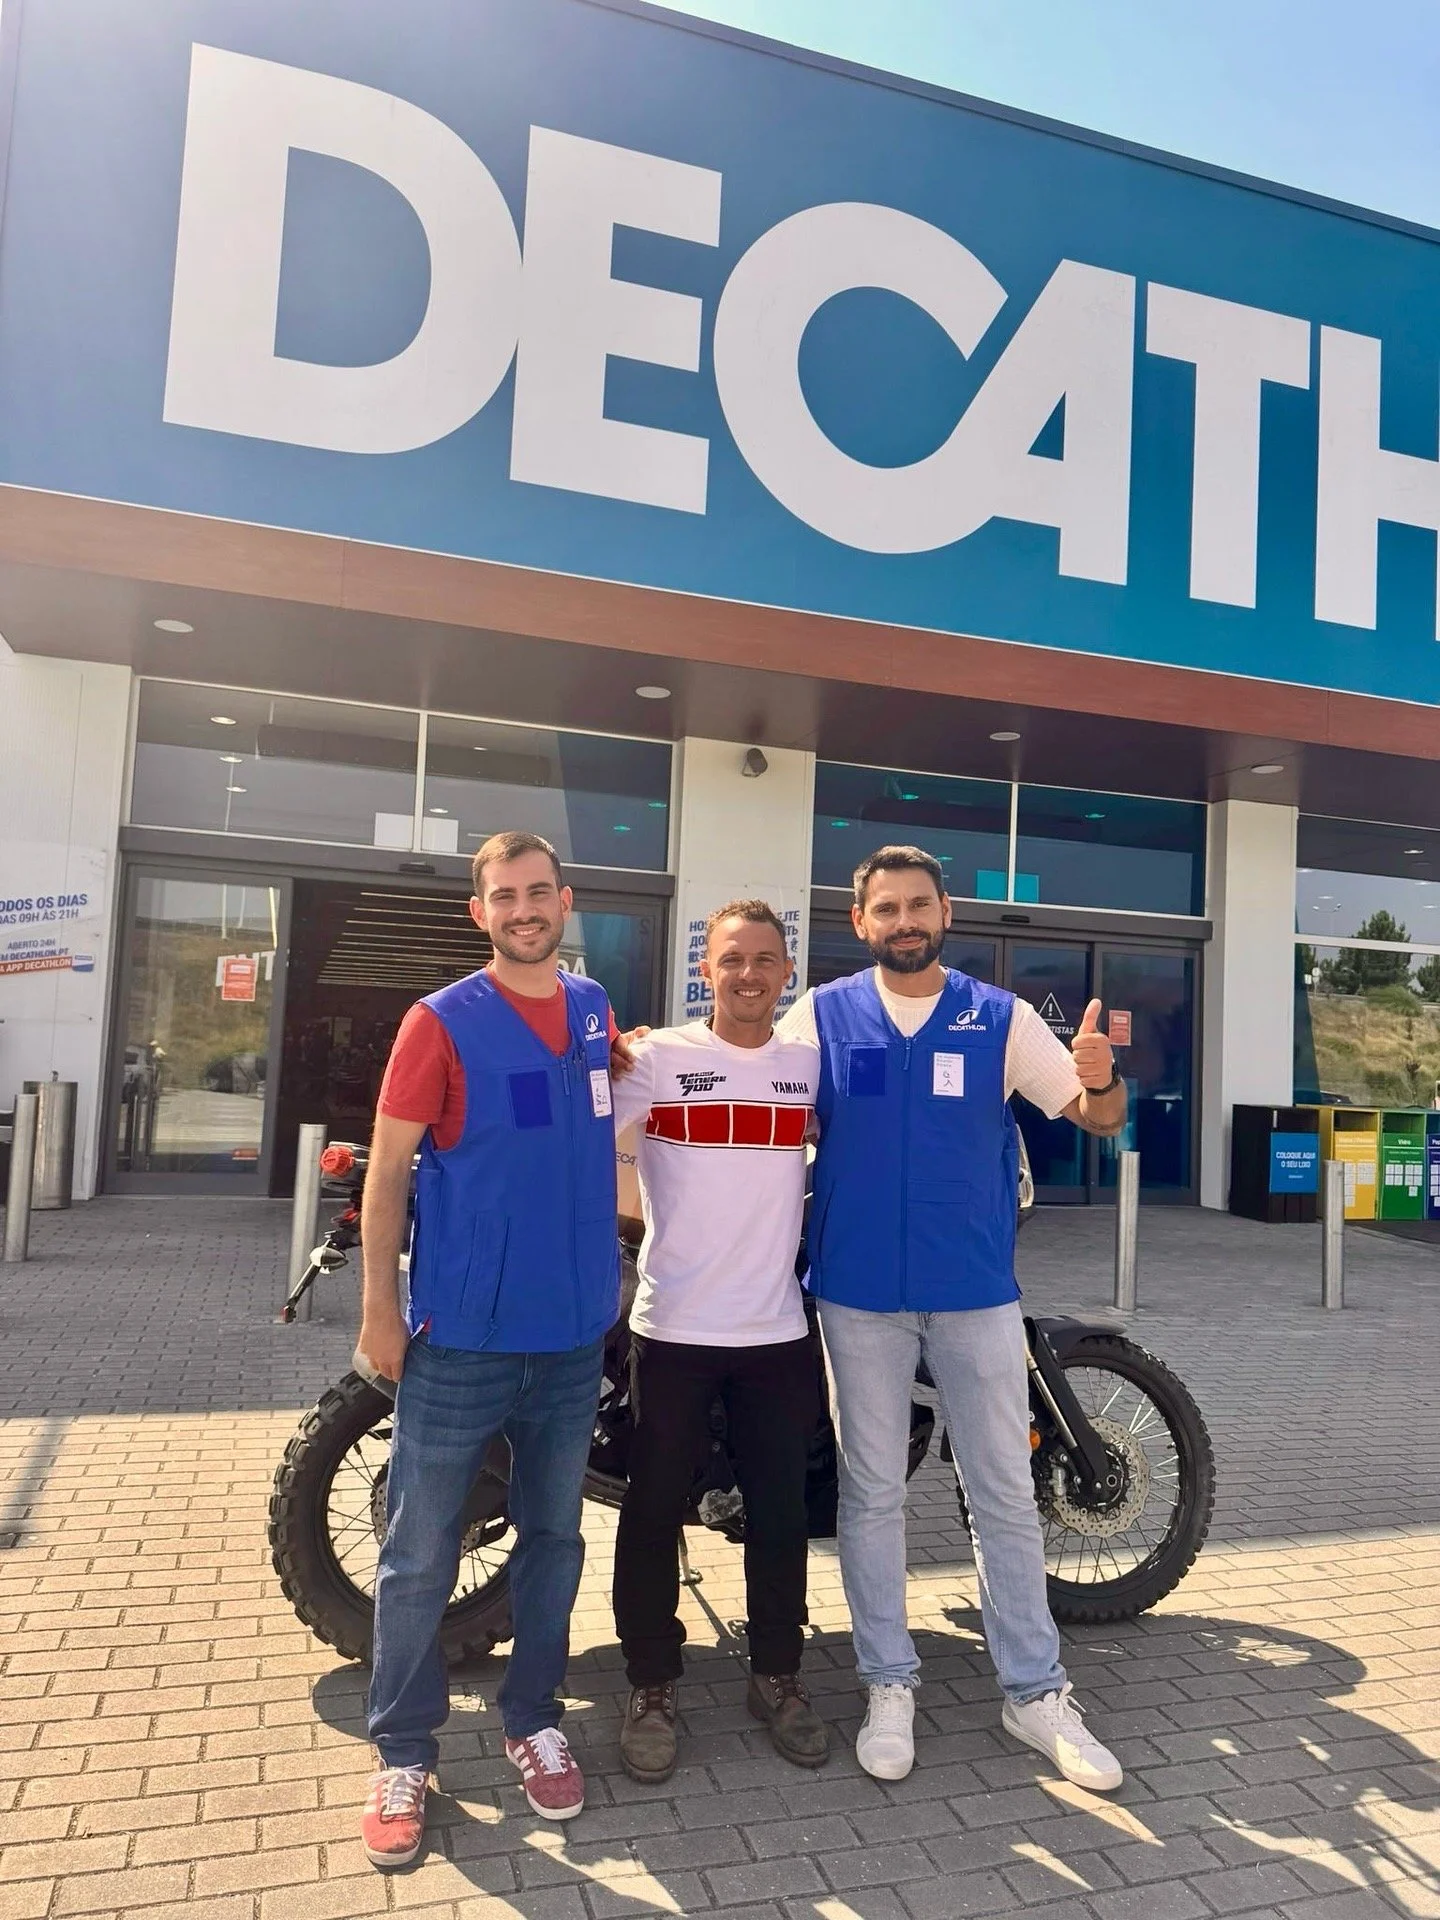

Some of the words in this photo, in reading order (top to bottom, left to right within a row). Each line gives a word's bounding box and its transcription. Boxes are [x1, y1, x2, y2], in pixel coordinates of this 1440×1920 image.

[36, 896, 54, 909] OS
[58, 894, 88, 907] DIAS
[19, 911, 40, 923] 09H
[58, 908, 79, 920] 21H
[7, 939, 39, 950] ABERTO
[6, 962, 24, 972] APP
[24, 958, 72, 970] DECATHLON
[681, 1083, 714, 1096] 700
[771, 1081, 810, 1094] YAMAHA
